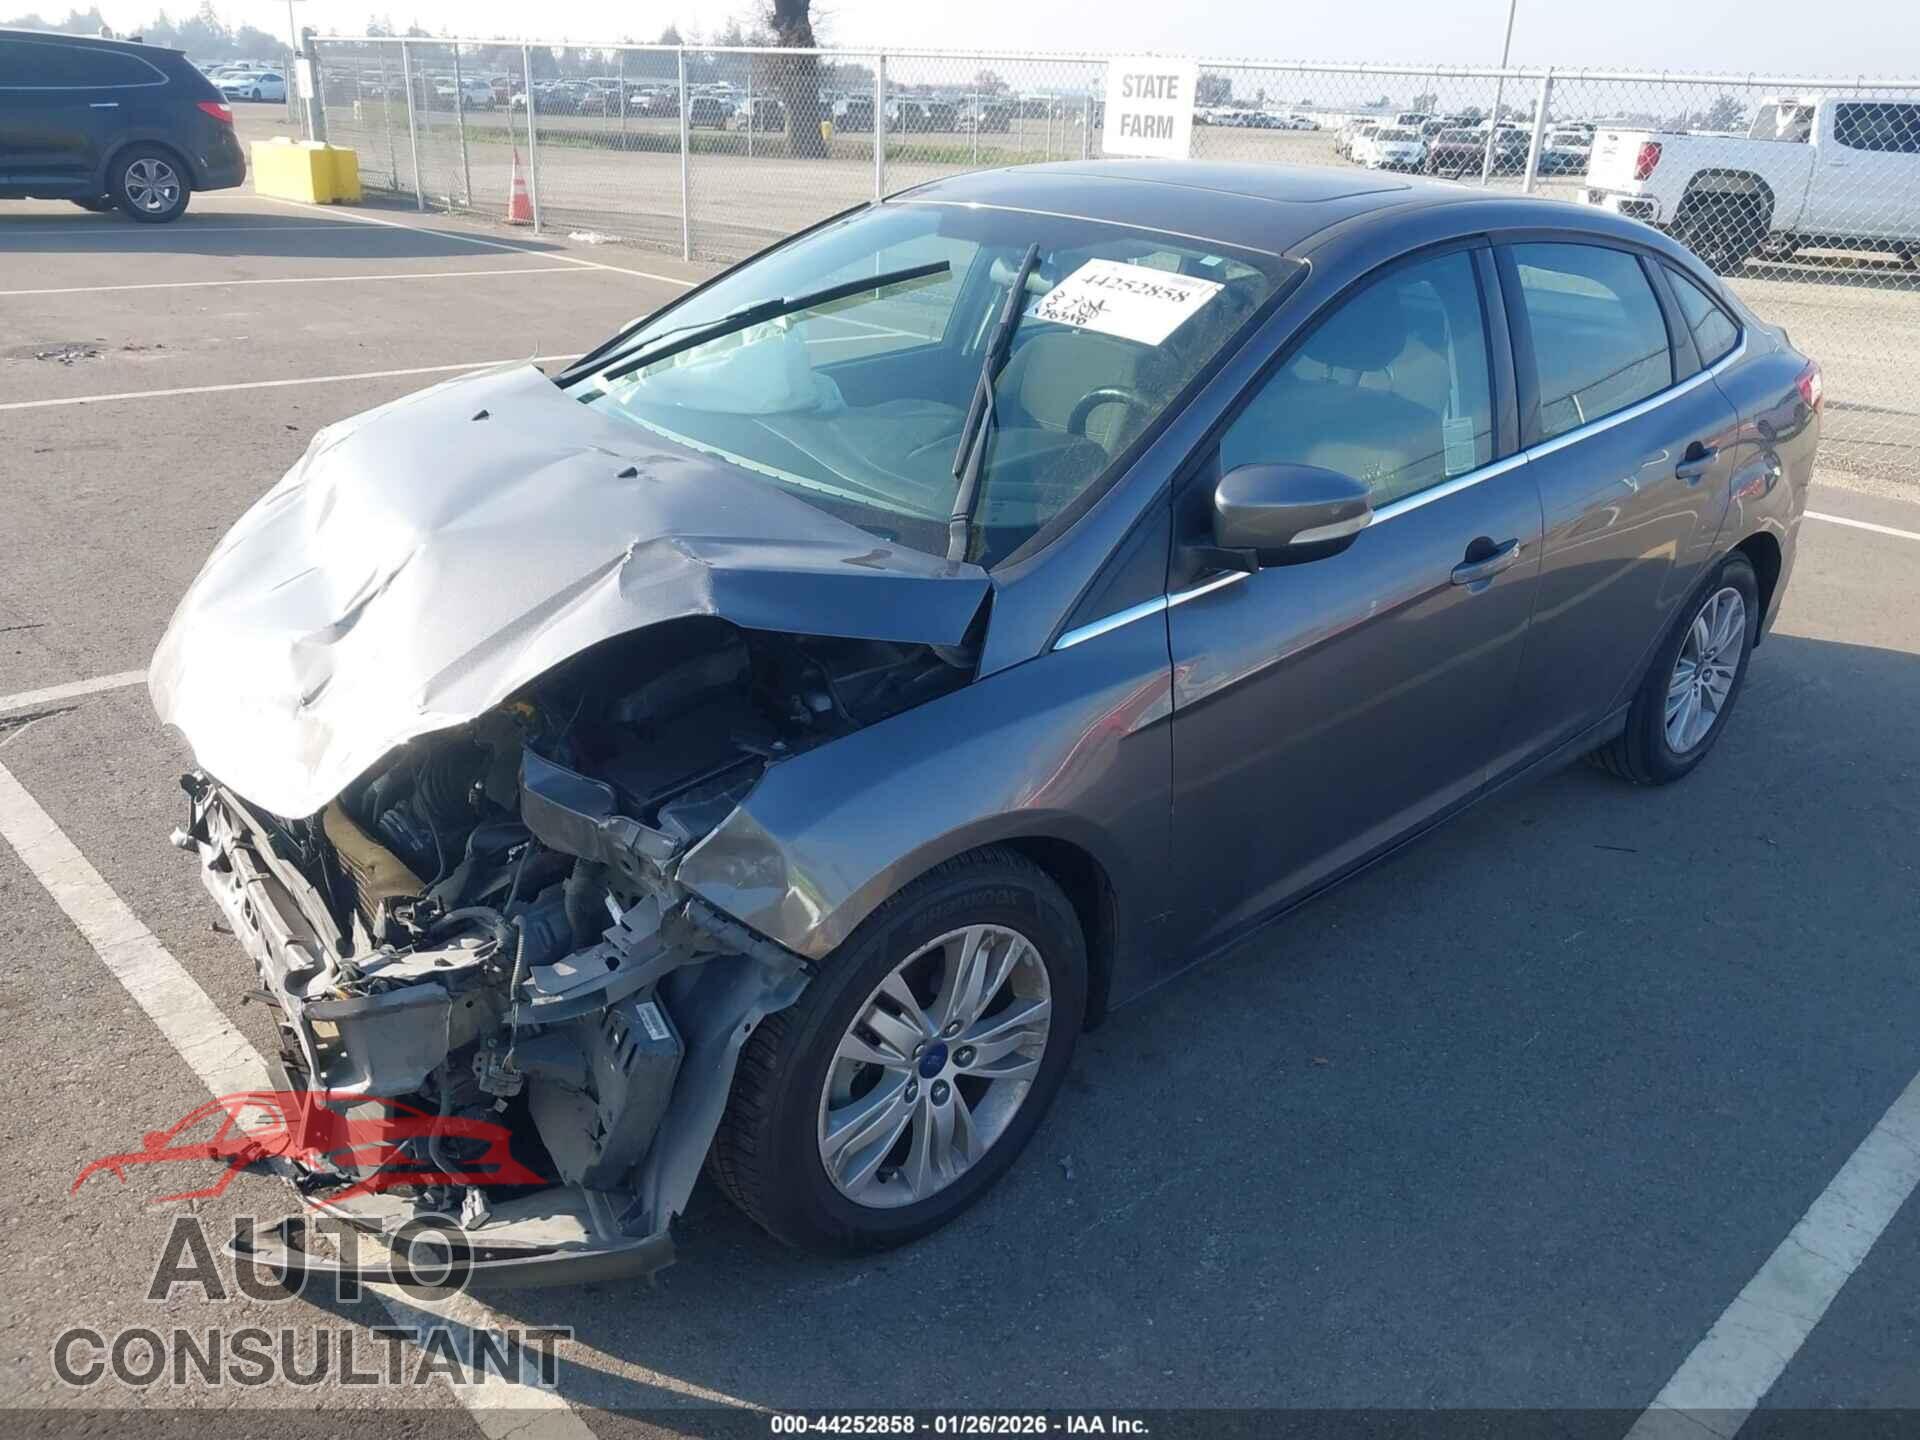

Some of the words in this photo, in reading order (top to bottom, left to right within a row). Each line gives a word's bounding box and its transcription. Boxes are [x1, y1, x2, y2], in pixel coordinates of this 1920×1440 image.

[1122, 73, 1179, 99] STATE
[1120, 113, 1174, 139] FARM
[1081, 274, 1191, 302] 44252858
